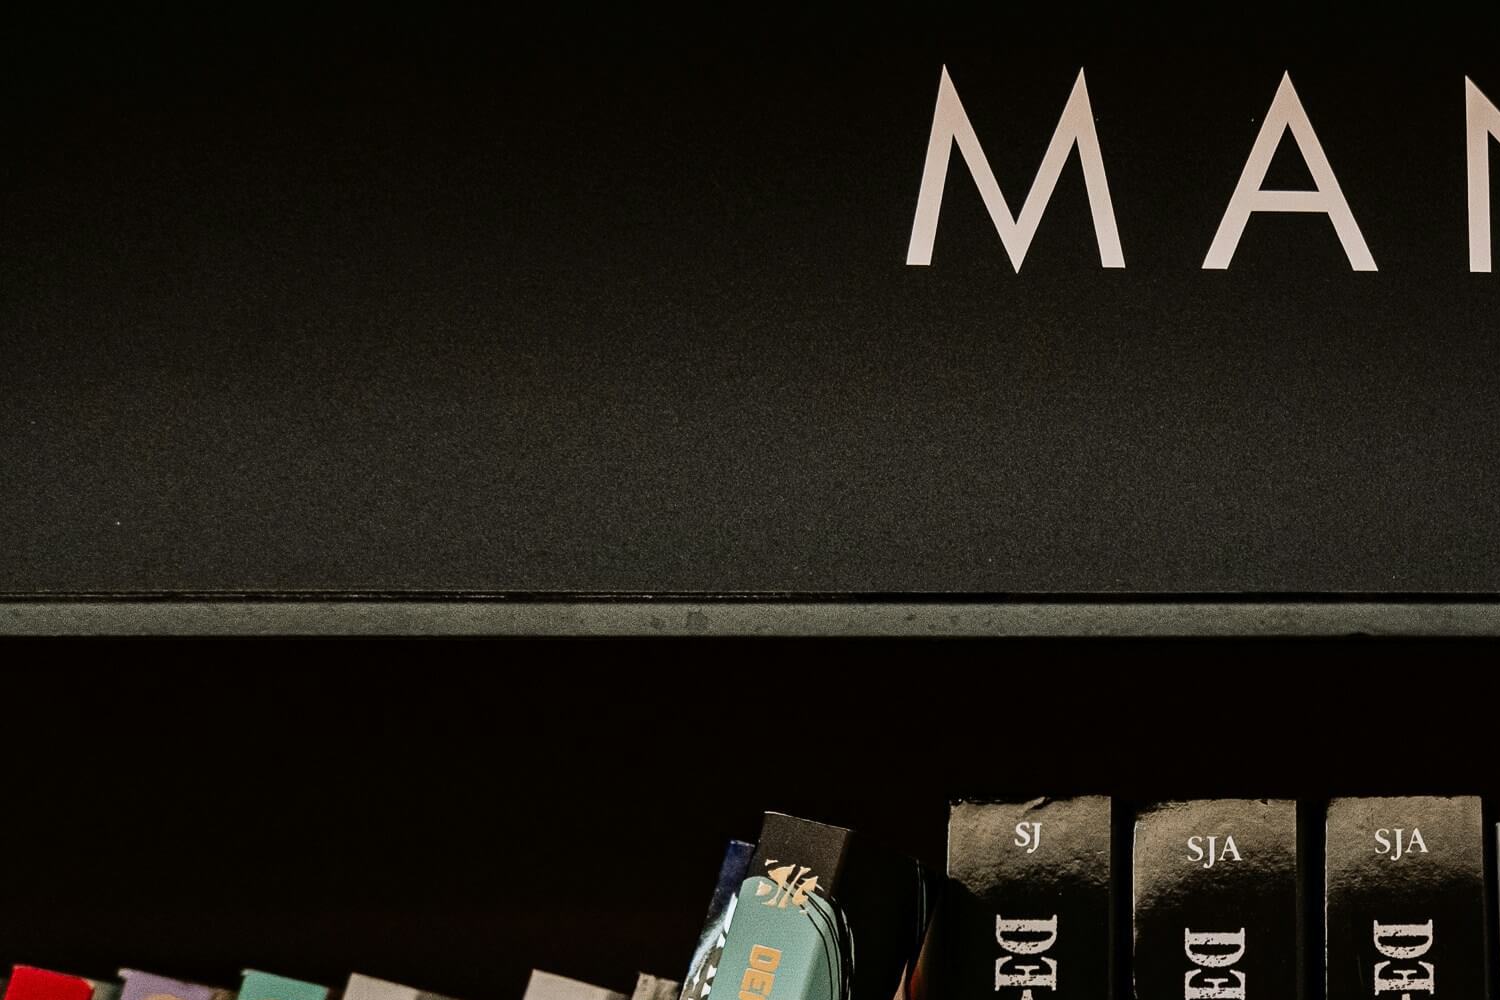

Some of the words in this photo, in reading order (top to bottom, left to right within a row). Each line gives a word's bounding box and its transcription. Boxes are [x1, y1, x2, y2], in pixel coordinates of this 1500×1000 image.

[1014, 822, 1043, 853] SJ
[1187, 836, 1242, 868] SJA
[1374, 828, 1429, 861] SJA
